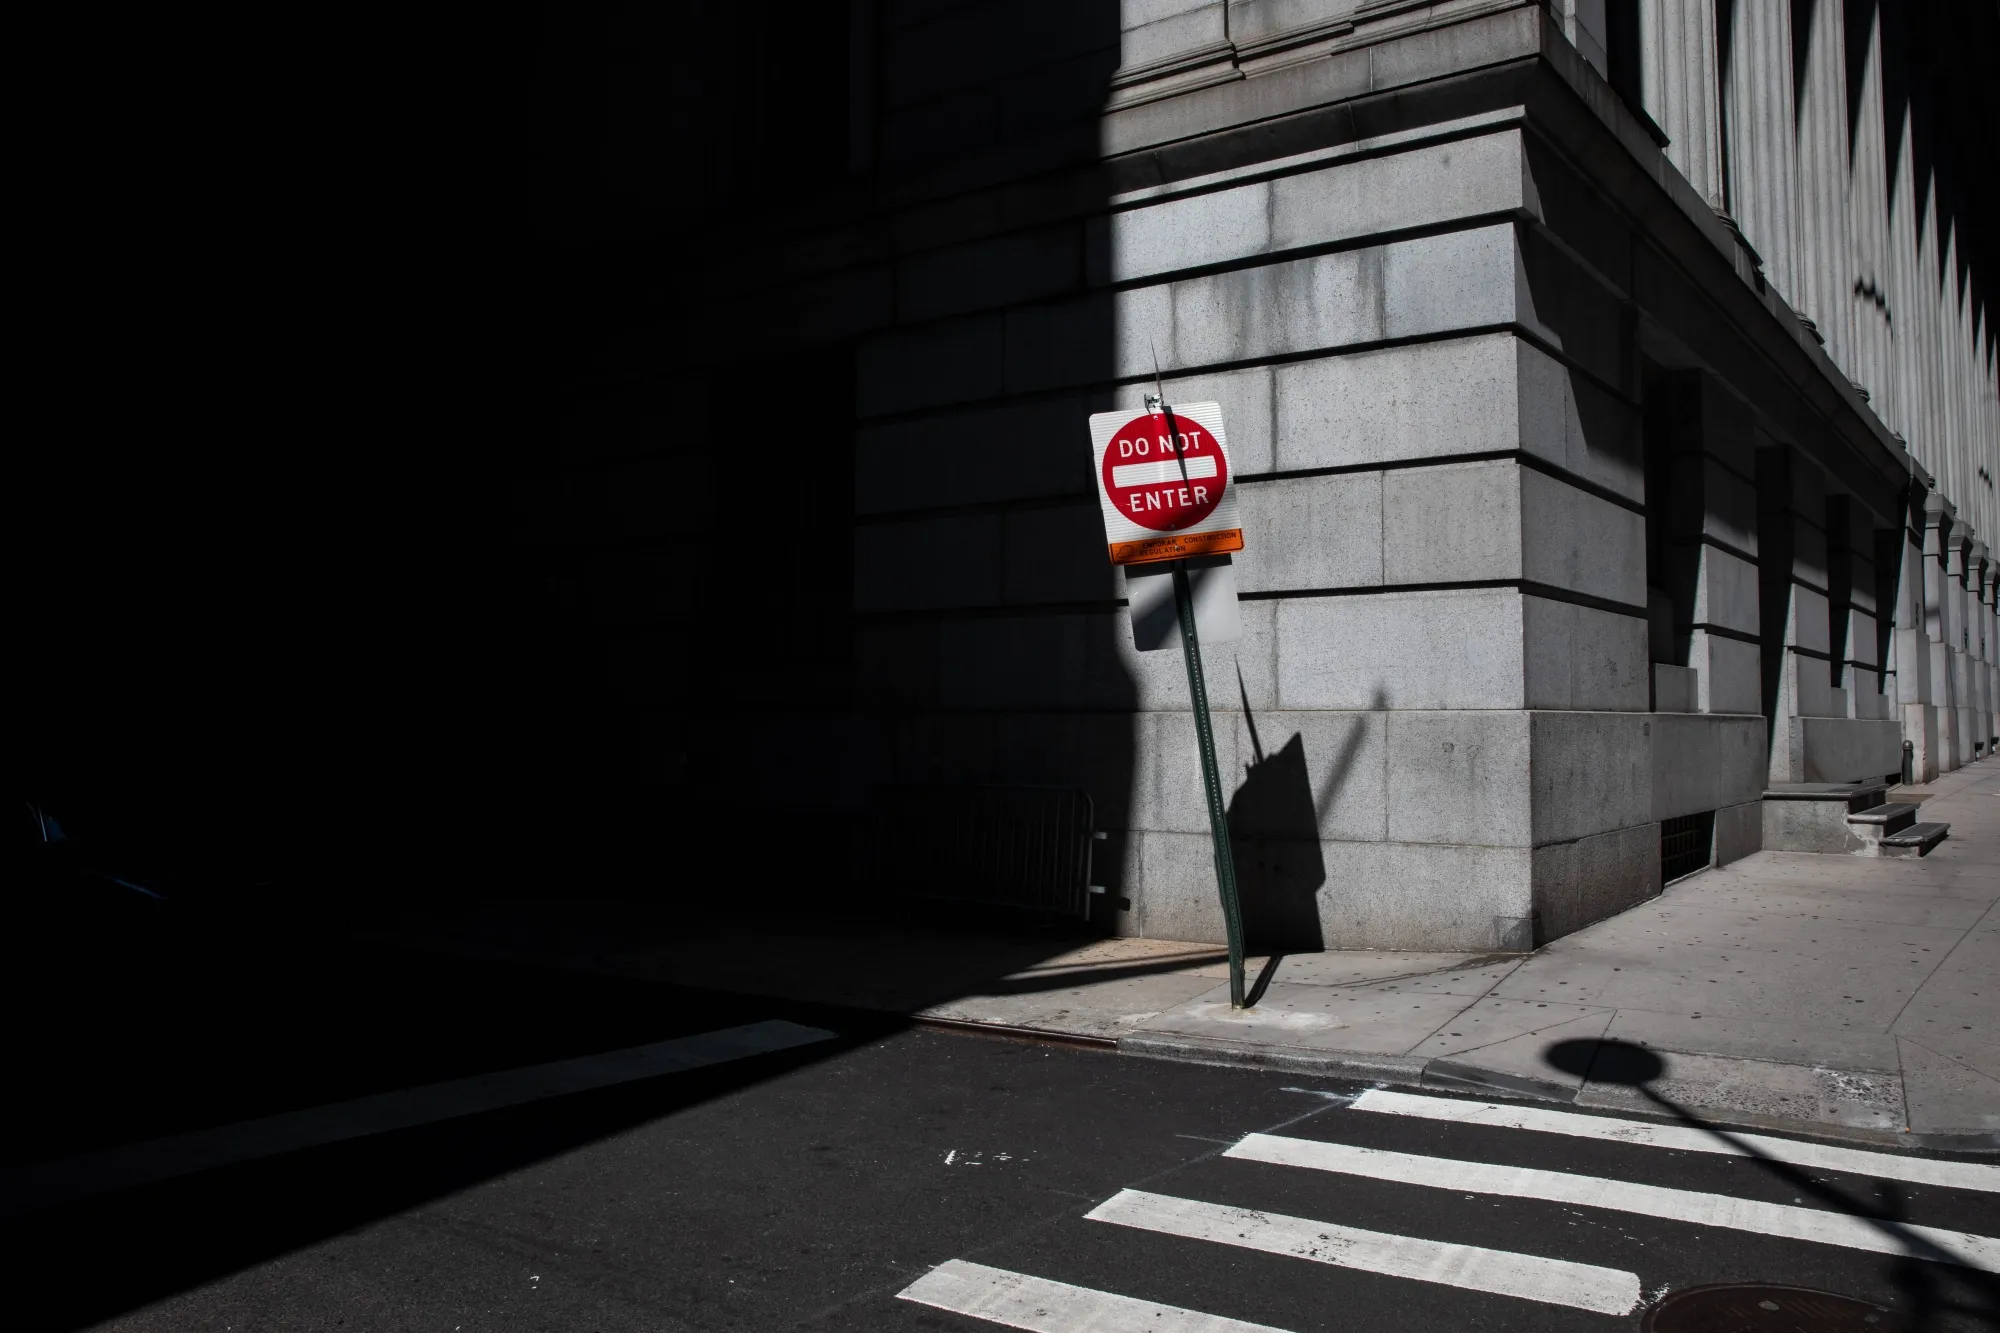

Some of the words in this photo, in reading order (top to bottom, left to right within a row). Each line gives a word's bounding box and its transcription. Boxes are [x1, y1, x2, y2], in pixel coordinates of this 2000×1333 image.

[1119, 437, 1149, 458] DO
[1159, 431, 1200, 453] NOT
[1130, 486, 1209, 512] ENTER
[1141, 538, 1178, 549] EMPORAR
[1184, 532, 1237, 544] CONSTRUCTION
